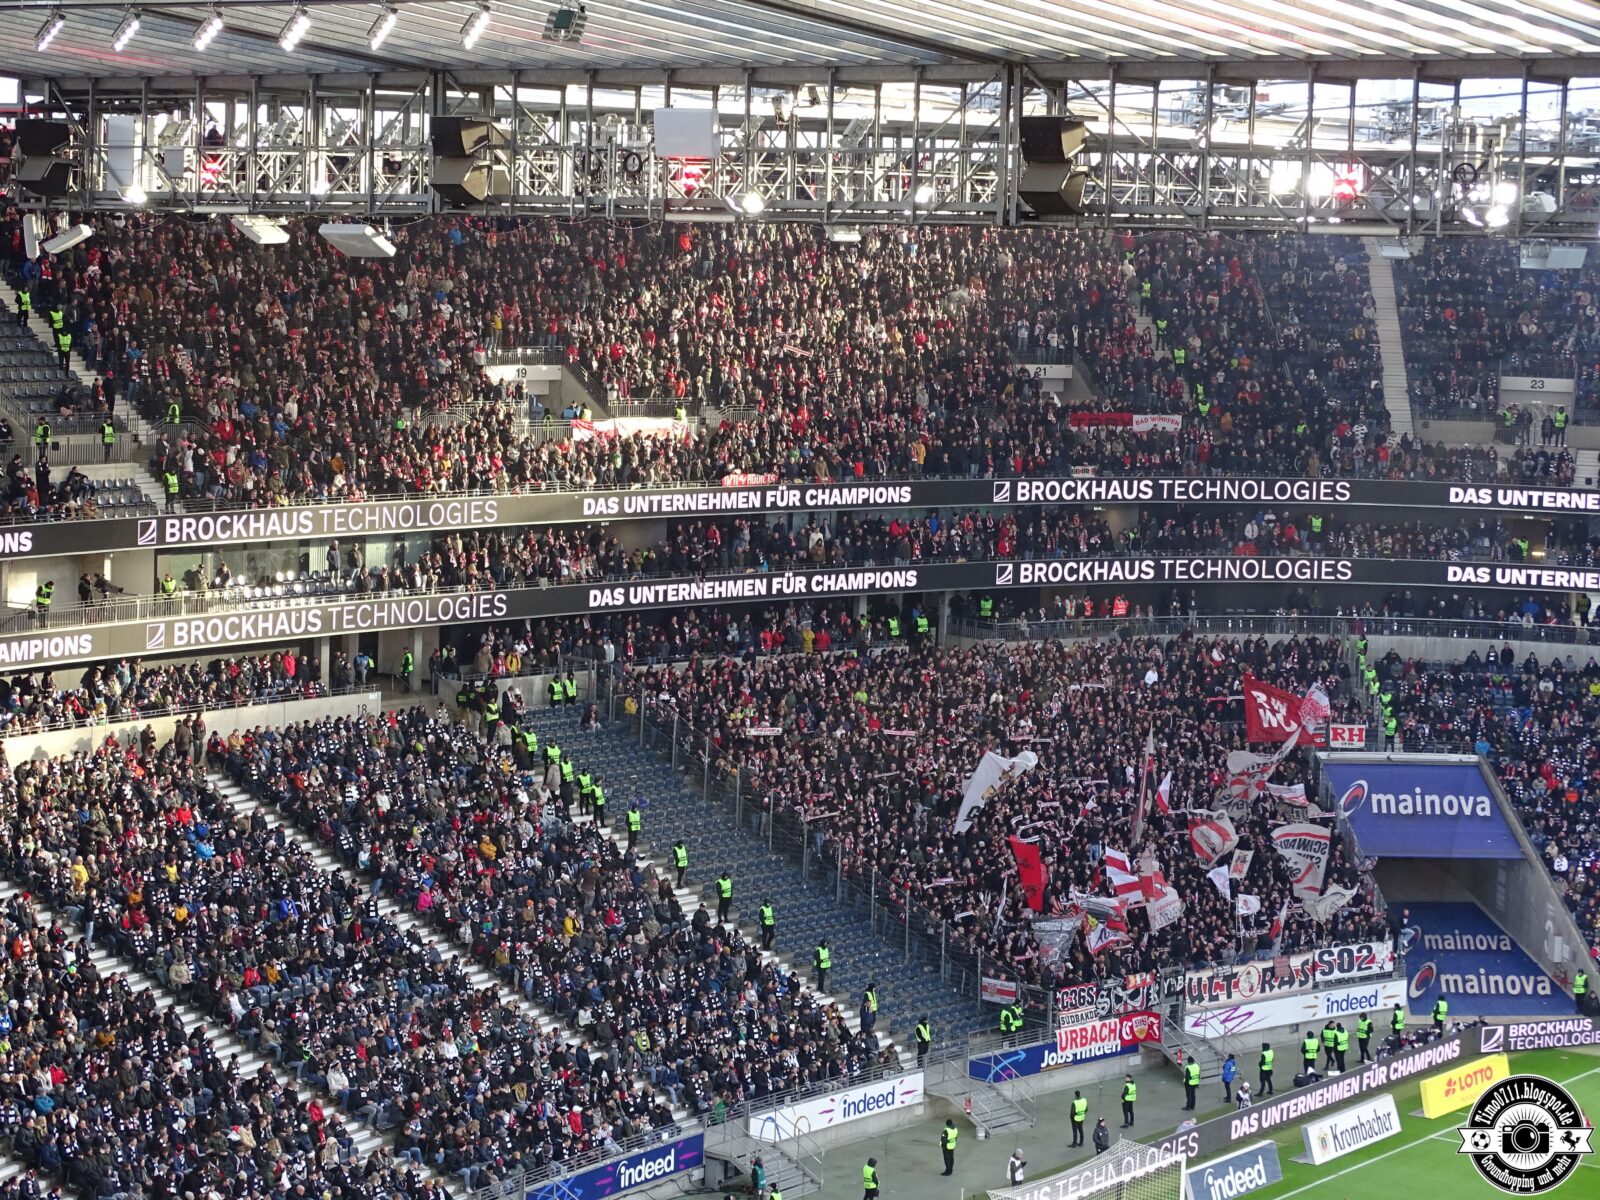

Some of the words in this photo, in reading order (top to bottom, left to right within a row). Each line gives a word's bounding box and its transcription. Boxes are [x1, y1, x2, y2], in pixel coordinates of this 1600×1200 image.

[516, 367, 527, 378] 19
[1530, 379, 1545, 389] 23
[583, 497, 619, 516] DAS
[624, 491, 761, 514] UNTERNEHMEN
[765, 485, 801, 508] FÜR
[805, 486, 912, 506] CHAMPIONS
[1017, 480, 1153, 501] BROCKHAUS
[1158, 479, 1351, 501] TECHNOLOGIES
[1450, 487, 1493, 505] DAS
[165, 511, 313, 543] BROCKHAUS
[319, 500, 498, 532] TECHNOLOGIES
[1019, 560, 1155, 583] BROCKHAUS
[1160, 559, 1352, 580] TECHNOLOGIES
[1447, 566, 1491, 583] DAS
[1496, 568, 1600, 589] UNTERNE
[588, 587, 625, 608] DAS
[629, 578, 767, 605] UNTERNEHMEN
[771, 572, 807, 595] FÜR
[811, 570, 918, 592] CHAMPIONS
[174, 610, 322, 646] BROCKHAUS
[328, 593, 507, 630] TECHNOLOGIES
[357, 703, 368, 717] 18
[127, 732, 138, 746] 16
[1331, 727, 1365, 743] RH
[1371, 787, 1491, 817] mainova
[1424, 930, 1511, 951] mainova
[1440, 968, 1551, 996] mainova
[1324, 989, 1378, 1015] indeed
[1057, 1021, 1119, 1053] URBACH
[1509, 1018, 1593, 1037] BROCKHAUS
[1040, 1048, 1073, 1068] Jobs
[1230, 1112, 1259, 1140] DAS
[1261, 1078, 1361, 1124] UNTERNEHMEN
[1362, 1061, 1389, 1089] FÜR
[1389, 1039, 1461, 1080] CHAMPIONS
[1458, 1066, 1493, 1091] LOTTO
[839, 1085, 896, 1119] indeed
[1329, 1108, 1393, 1153] Krombacher
[615, 1149, 676, 1189] indeed
[1204, 1155, 1267, 1200] indeed
